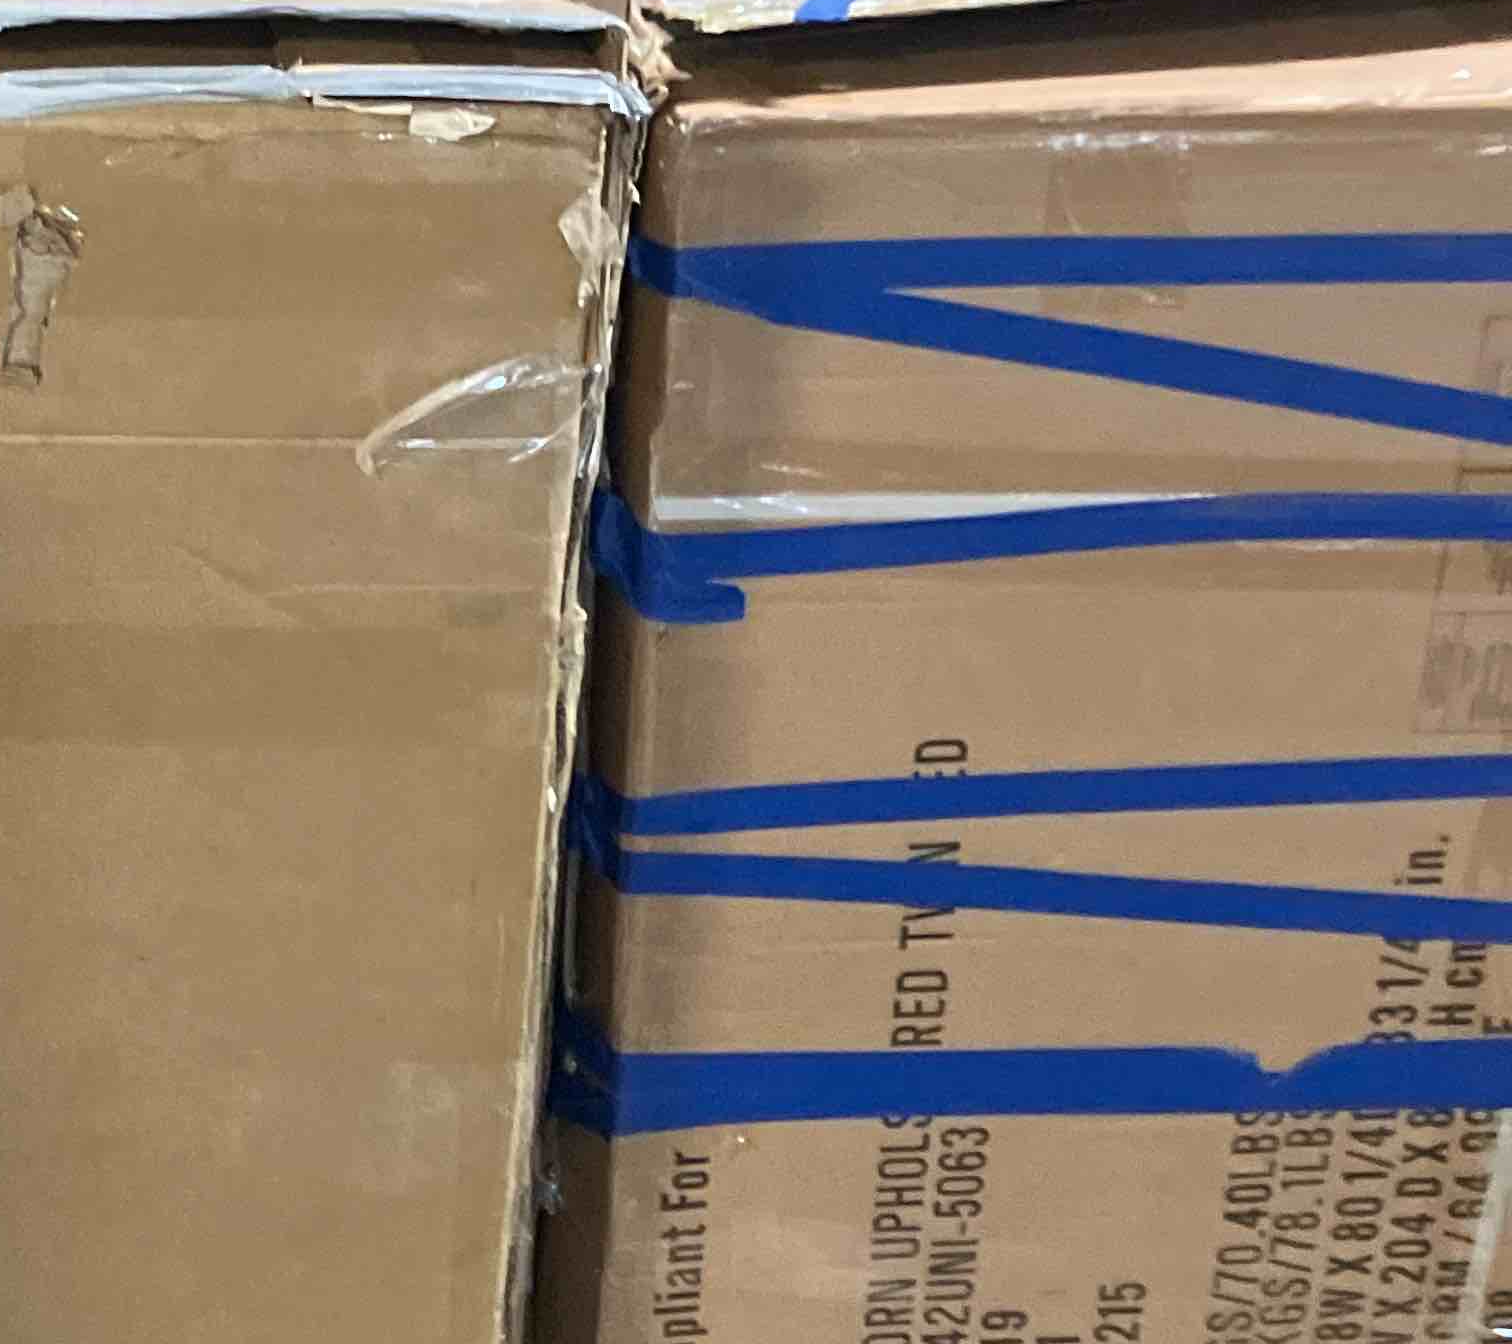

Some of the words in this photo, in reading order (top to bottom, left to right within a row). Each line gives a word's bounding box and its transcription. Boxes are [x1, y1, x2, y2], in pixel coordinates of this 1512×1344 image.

[1392, 834, 1450, 886] in.
[1430, 1004, 1477, 1027] H
[1400, 1142, 1449, 1164] X
[659, 1150, 710, 1212] For
[1394, 1176, 1443, 1198] D
[1330, 1196, 1384, 1242] 80
[1377, 1213, 1436, 1285] 204
[1324, 1254, 1373, 1277] X
[1370, 1296, 1422, 1318] X
